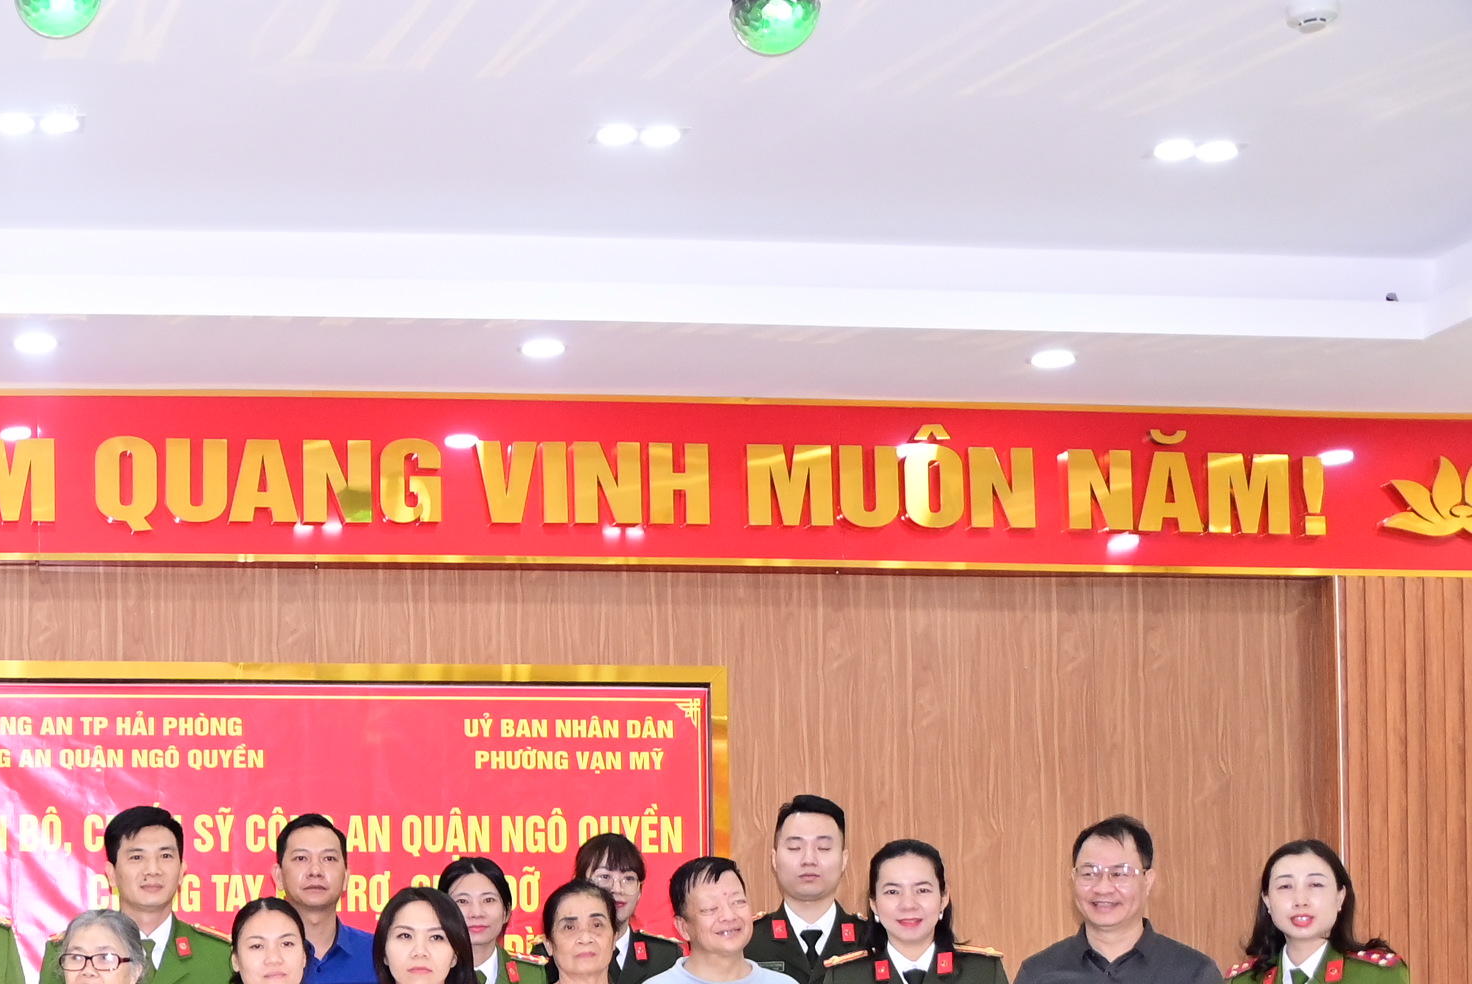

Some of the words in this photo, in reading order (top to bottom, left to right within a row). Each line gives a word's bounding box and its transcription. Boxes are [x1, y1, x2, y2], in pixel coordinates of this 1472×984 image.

[95, 437, 443, 532] QUANG
[476, 440, 711, 527] VINH
[745, 423, 1036, 530] MUÔN
[1058, 429, 1327, 537] NĂM!
[39, 716, 73, 736] AN
[80, 717, 108, 736] TP
[116, 711, 154, 736] HẢI
[163, 711, 243, 737] PHÒNG
[464, 712, 493, 738] UỶ
[501, 719, 548, 738] BAN
[555, 716, 619, 738] NHÂN
[627, 716, 674, 739] DÂN
[19, 749, 51, 768] AN
[59, 746, 124, 773] QUẬN
[132, 745, 179, 768] NGÔ
[188, 743, 265, 769] QUYỀN
[475, 747, 569, 770] PHƯỜNG
[576, 751, 622, 774] VẠN
[629, 748, 665, 770] MỸ
[193, 810, 236, 853] SỸ
[346, 815, 390, 853] AN
[401, 807, 490, 862] QUẬN
[502, 807, 568, 853] NGÔ
[211, 874, 265, 912] TAY
[336, 870, 391, 920] RỢ
